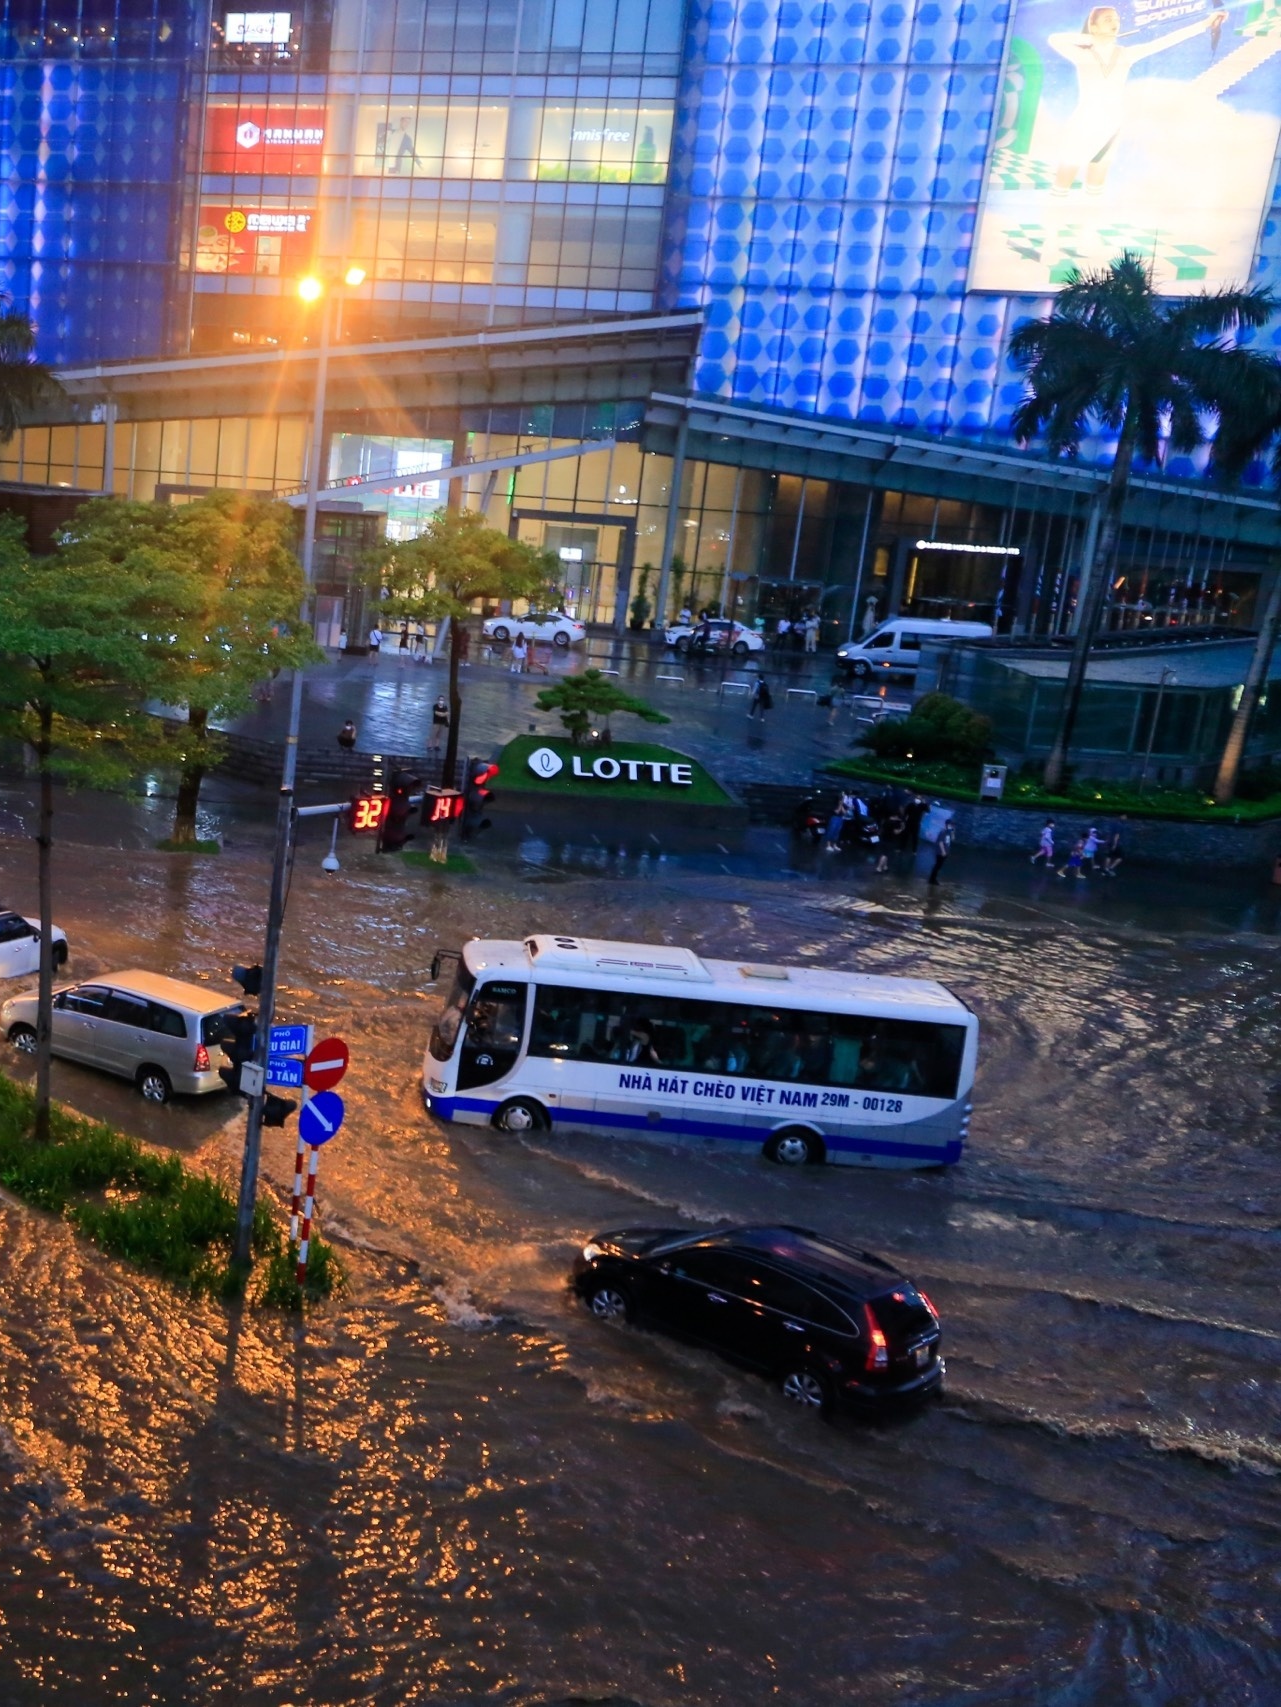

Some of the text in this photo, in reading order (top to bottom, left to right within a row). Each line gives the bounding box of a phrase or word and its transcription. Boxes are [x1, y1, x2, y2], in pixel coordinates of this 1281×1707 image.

[573, 756, 693, 785] LOTTE
[354, 799, 382, 829] 32
[280, 1039, 301, 1051] GIAI
[619, 1072, 652, 1091] NHÀ
[658, 1075, 689, 1094] HÁT
[693, 1080, 736, 1099] CHÈO
[741, 1084, 776, 1106] VIỆT
[779, 1089, 819, 1108] NAM
[820, 1092, 850, 1108] 29M
[862, 1096, 903, 1113] 00128
